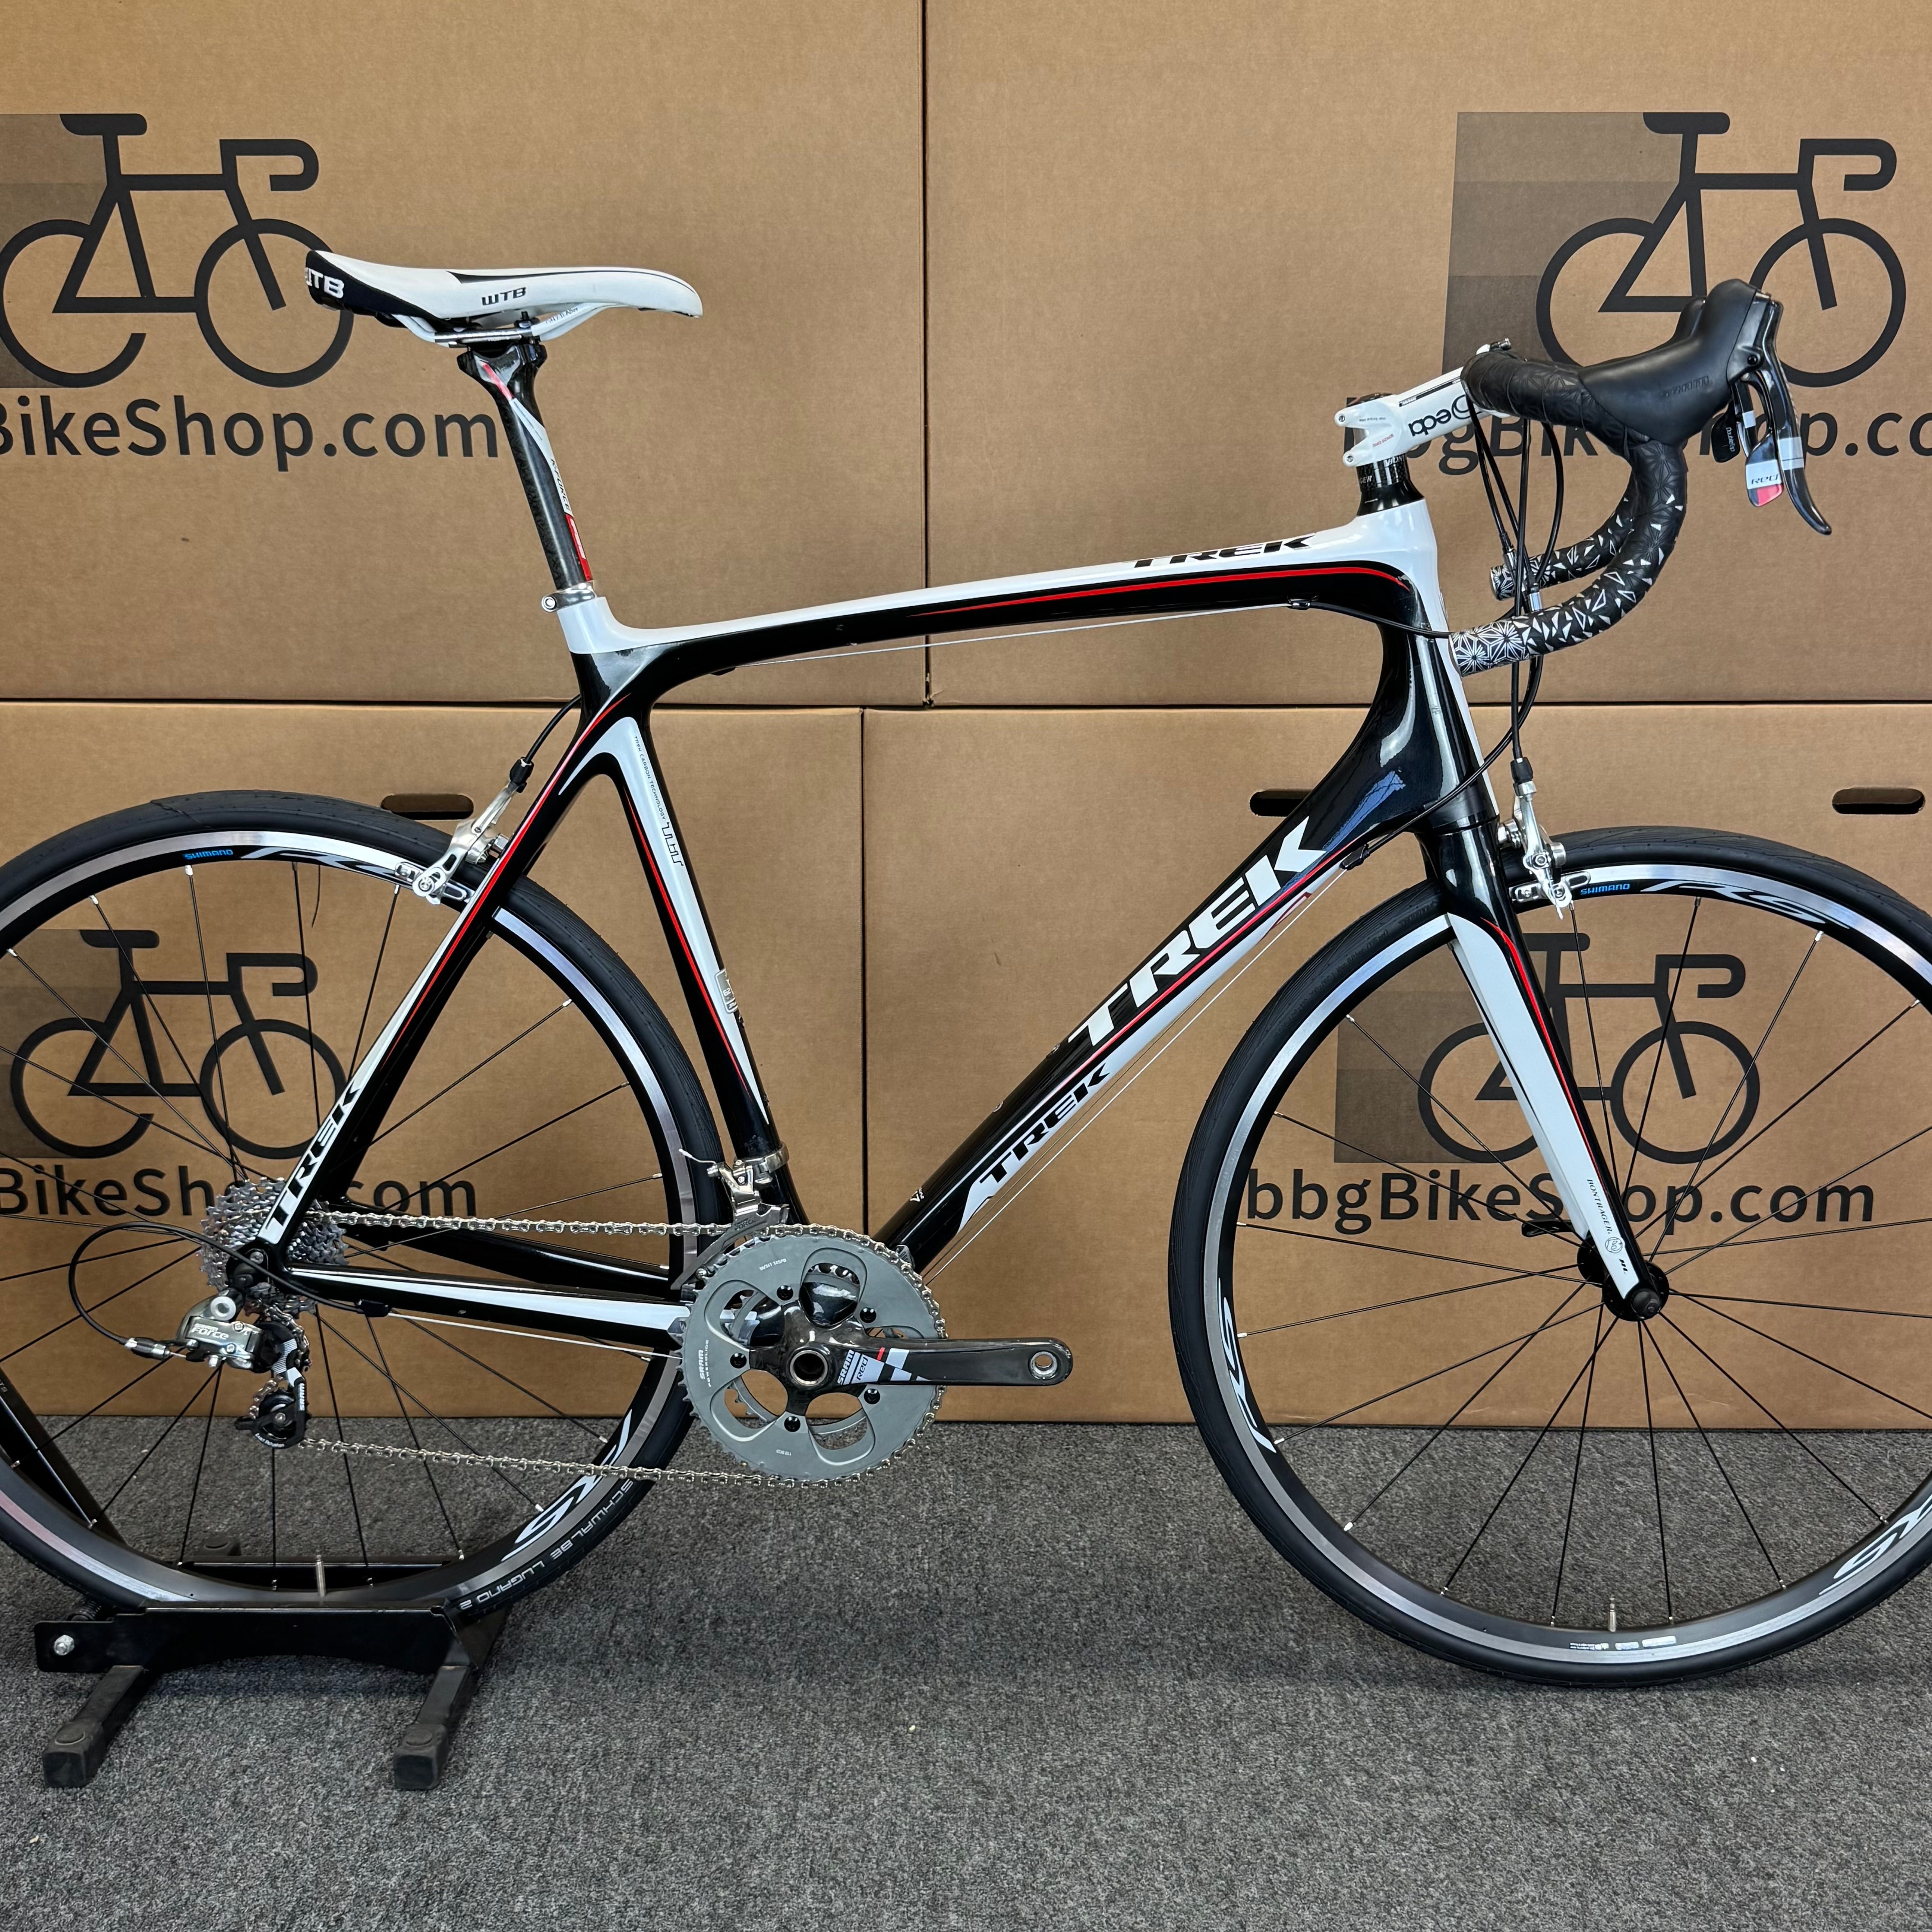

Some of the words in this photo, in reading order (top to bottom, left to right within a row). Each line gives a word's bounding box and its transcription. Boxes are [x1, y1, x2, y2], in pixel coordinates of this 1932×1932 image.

[482, 287, 526, 306] WTB
[1408, 394, 1478, 437] Deda
[1134, 535, 1316, 568] TREK
[640, 754, 651, 779] CARBON
[649, 781, 667, 820] TECHNOLOGY
[184, 849, 234, 860] SHIMANO
[1580, 883, 1630, 895] SHIMANO
[1640, 880, 1850, 929] RS
[1067, 815, 1326, 1046] TREK
[979, 1063, 1112, 1183] TREK
[265, 1080, 361, 1230] TREK
[1247, 1168, 1874, 1235] bbgBikeSop.com
[1587, 1179, 1613, 1234] BONTRAGER
[191, 1327, 229, 1340] Force
[837, 1349, 855, 1385] SRAM
[550, 1478, 634, 1560] SCHWALBE
[476, 1560, 545, 1604] LUGANO
[459, 1599, 473, 1610] 2
